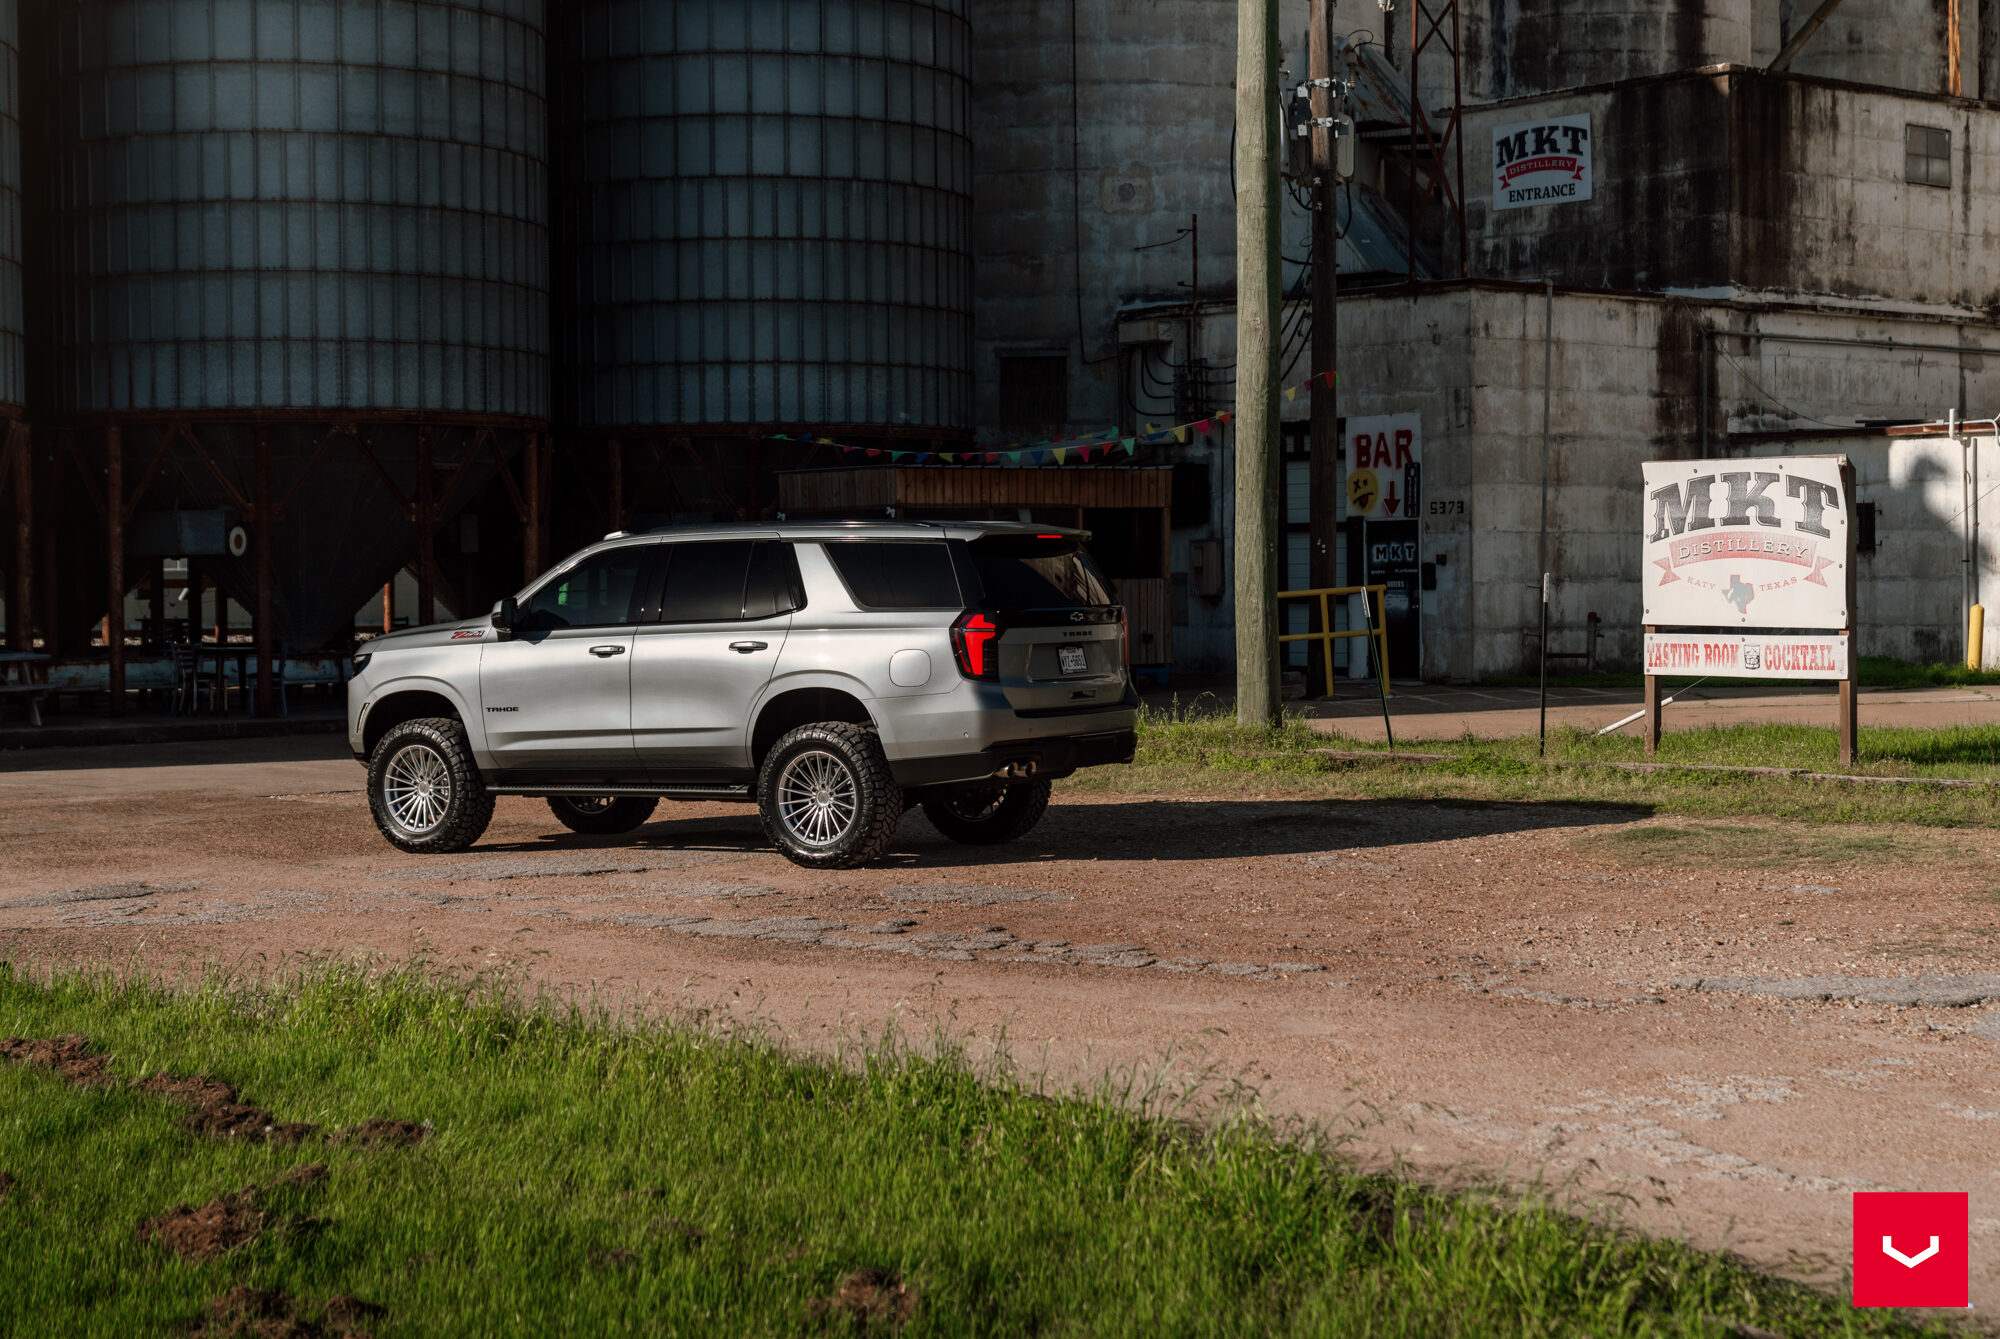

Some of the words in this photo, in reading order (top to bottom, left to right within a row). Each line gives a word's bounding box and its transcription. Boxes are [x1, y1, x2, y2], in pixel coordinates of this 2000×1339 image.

[1496, 125, 1588, 169] MKT
[1509, 159, 1574, 176] DISTILLERY
[1508, 183, 1576, 203] ENTRANCE
[1355, 429, 1414, 470] BAR
[1430, 501, 1464, 515] 5373
[1650, 471, 1840, 544] MKT
[1374, 543, 1416, 562] MKT
[1679, 540, 1809, 560] DISTILLERY
[1687, 576, 1717, 591] KATY
[1759, 576, 1798, 592] TEXAS
[1647, 642, 1700, 669] TASTING
